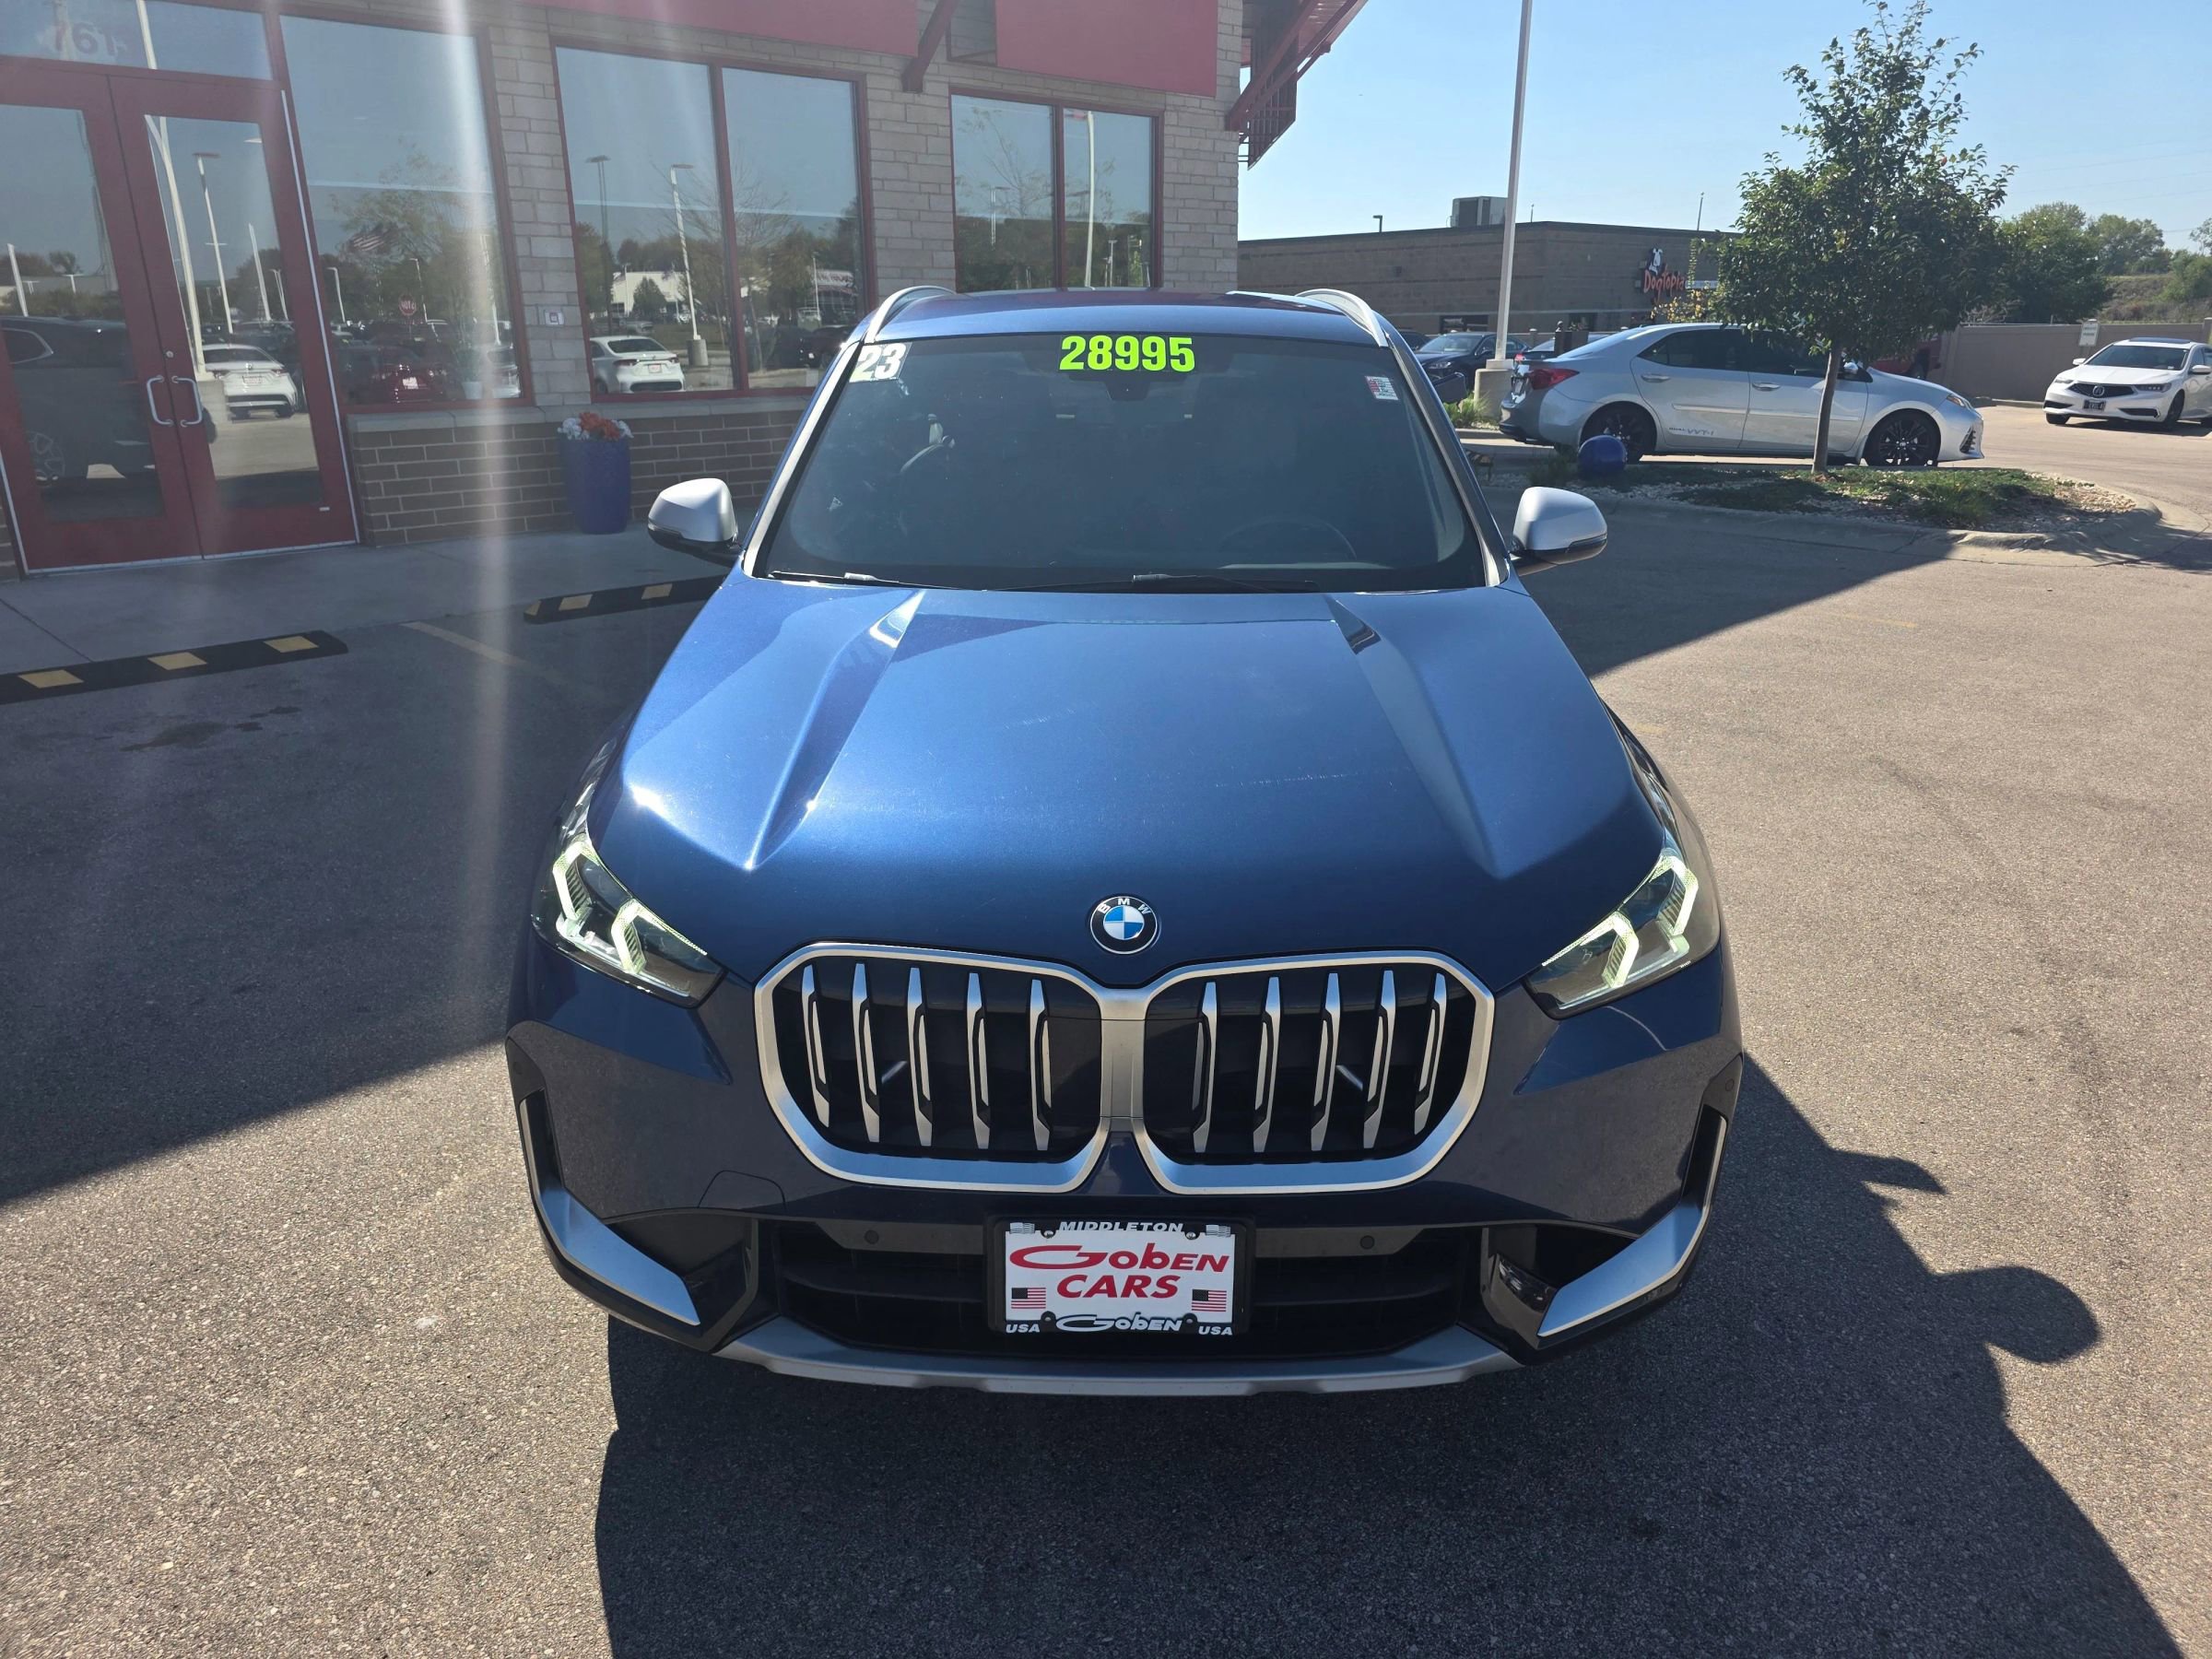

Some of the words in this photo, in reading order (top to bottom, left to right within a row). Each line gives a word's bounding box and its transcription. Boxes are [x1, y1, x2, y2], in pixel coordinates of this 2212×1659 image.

[849, 343, 906, 382] 23
[1060, 335, 1195, 371] 28995
[1097, 898, 1151, 914] BMW
[1059, 1221, 1183, 1232] MIDDLETON
[1056, 1274, 1181, 1299] CARS
[1006, 1324, 1041, 1334] USA
[1198, 1325, 1233, 1335] USA
